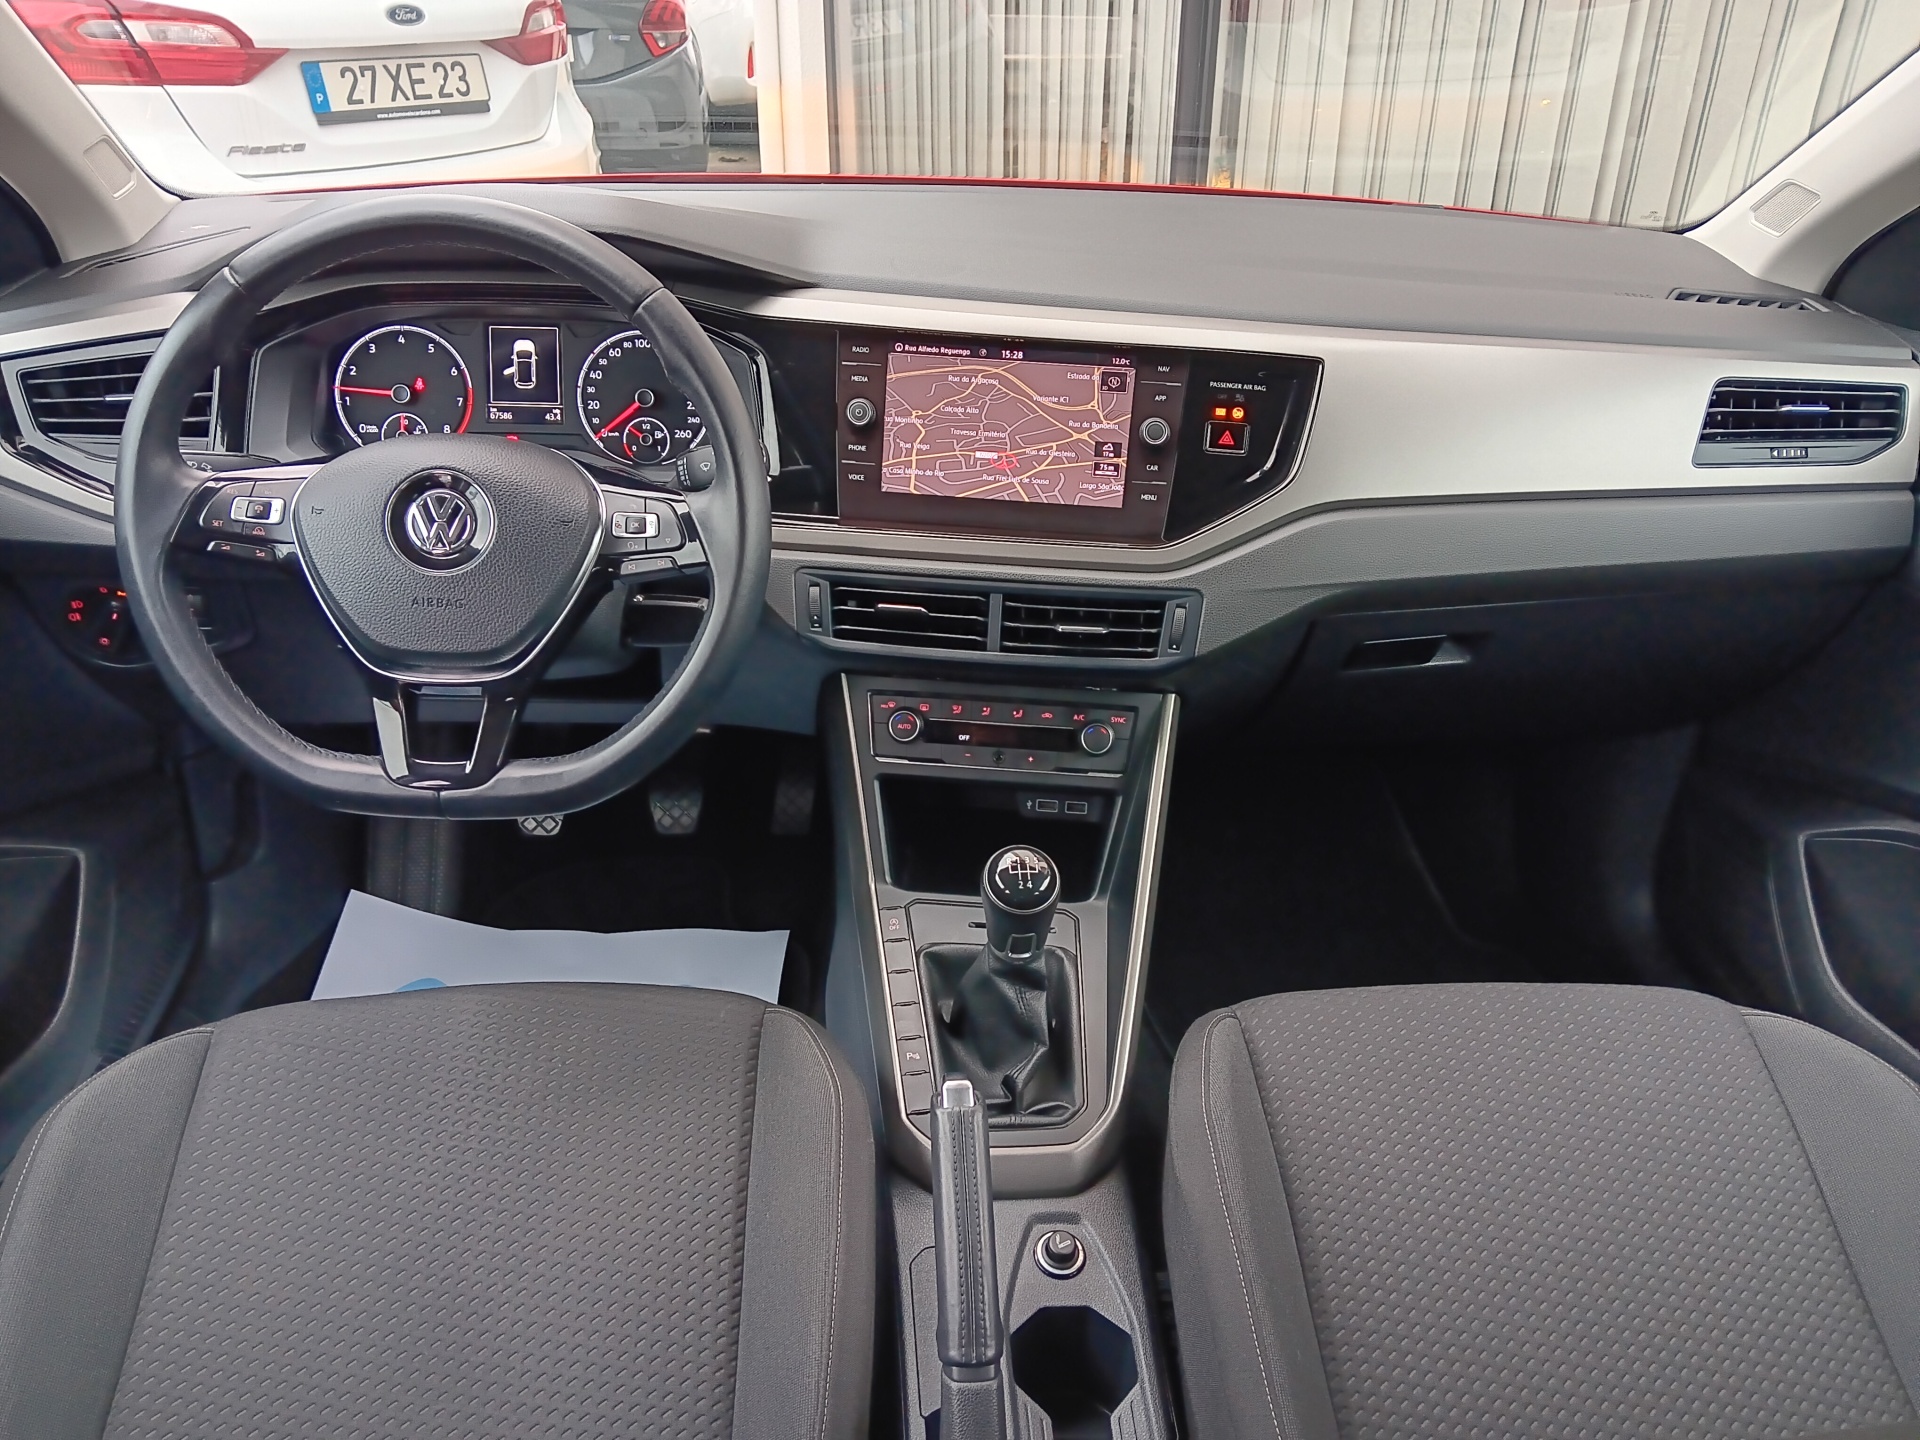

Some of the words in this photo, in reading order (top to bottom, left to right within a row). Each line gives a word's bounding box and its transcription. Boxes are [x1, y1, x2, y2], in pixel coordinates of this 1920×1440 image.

[395, 8, 416, 20] Ford
[316, 93, 324, 104] P
[227, 143, 306, 157] Fiesta
[398, 334, 406, 344] 4
[368, 344, 376, 353] 3
[428, 344, 435, 353] 5
[608, 348, 621, 357] 60
[918, 345, 939, 353] Alfredo
[941, 347, 970, 356] Reguengo
[1002, 350, 1023, 359] 15:28
[350, 366, 356, 376] 2
[450, 367, 458, 376] 6
[590, 370, 602, 379] 40
[1210, 381, 1242, 389] PASSENGER
[345, 396, 350, 406] 1
[457, 398, 463, 406] 7
[588, 400, 600, 409] 20
[940, 405, 964, 413] Calçada
[359, 424, 366, 432] 0
[444, 424, 450, 434] 8
[950, 428, 976, 436] Travessa
[900, 440, 911, 448] Rua
[1080, 482, 1096, 490] Largo
[411, 598, 464, 609] AIRBAG
